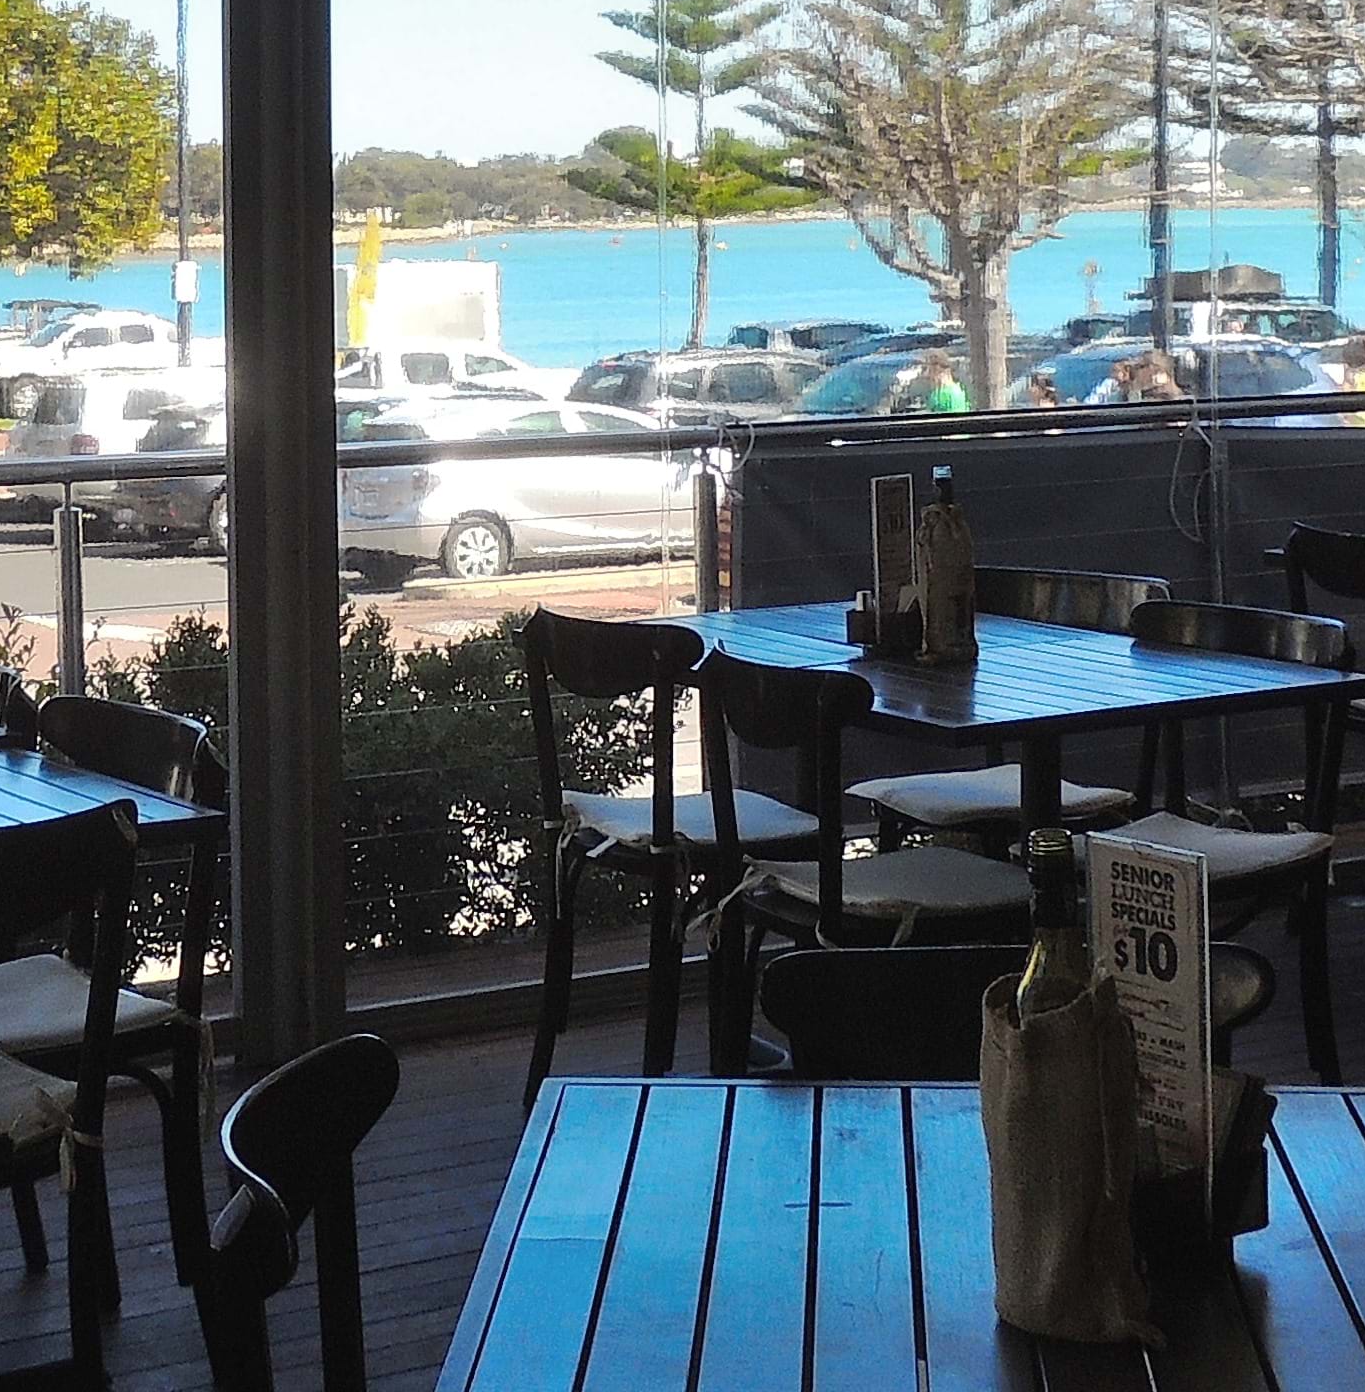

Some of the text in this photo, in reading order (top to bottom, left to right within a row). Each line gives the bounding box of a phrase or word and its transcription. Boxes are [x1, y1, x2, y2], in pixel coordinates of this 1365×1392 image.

[1110, 861, 1176, 893] SENIOR
[1111, 883, 1176, 912] LUNCH
[1111, 902, 1177, 931] SPECIALS
[1114, 926, 1178, 983] $10
